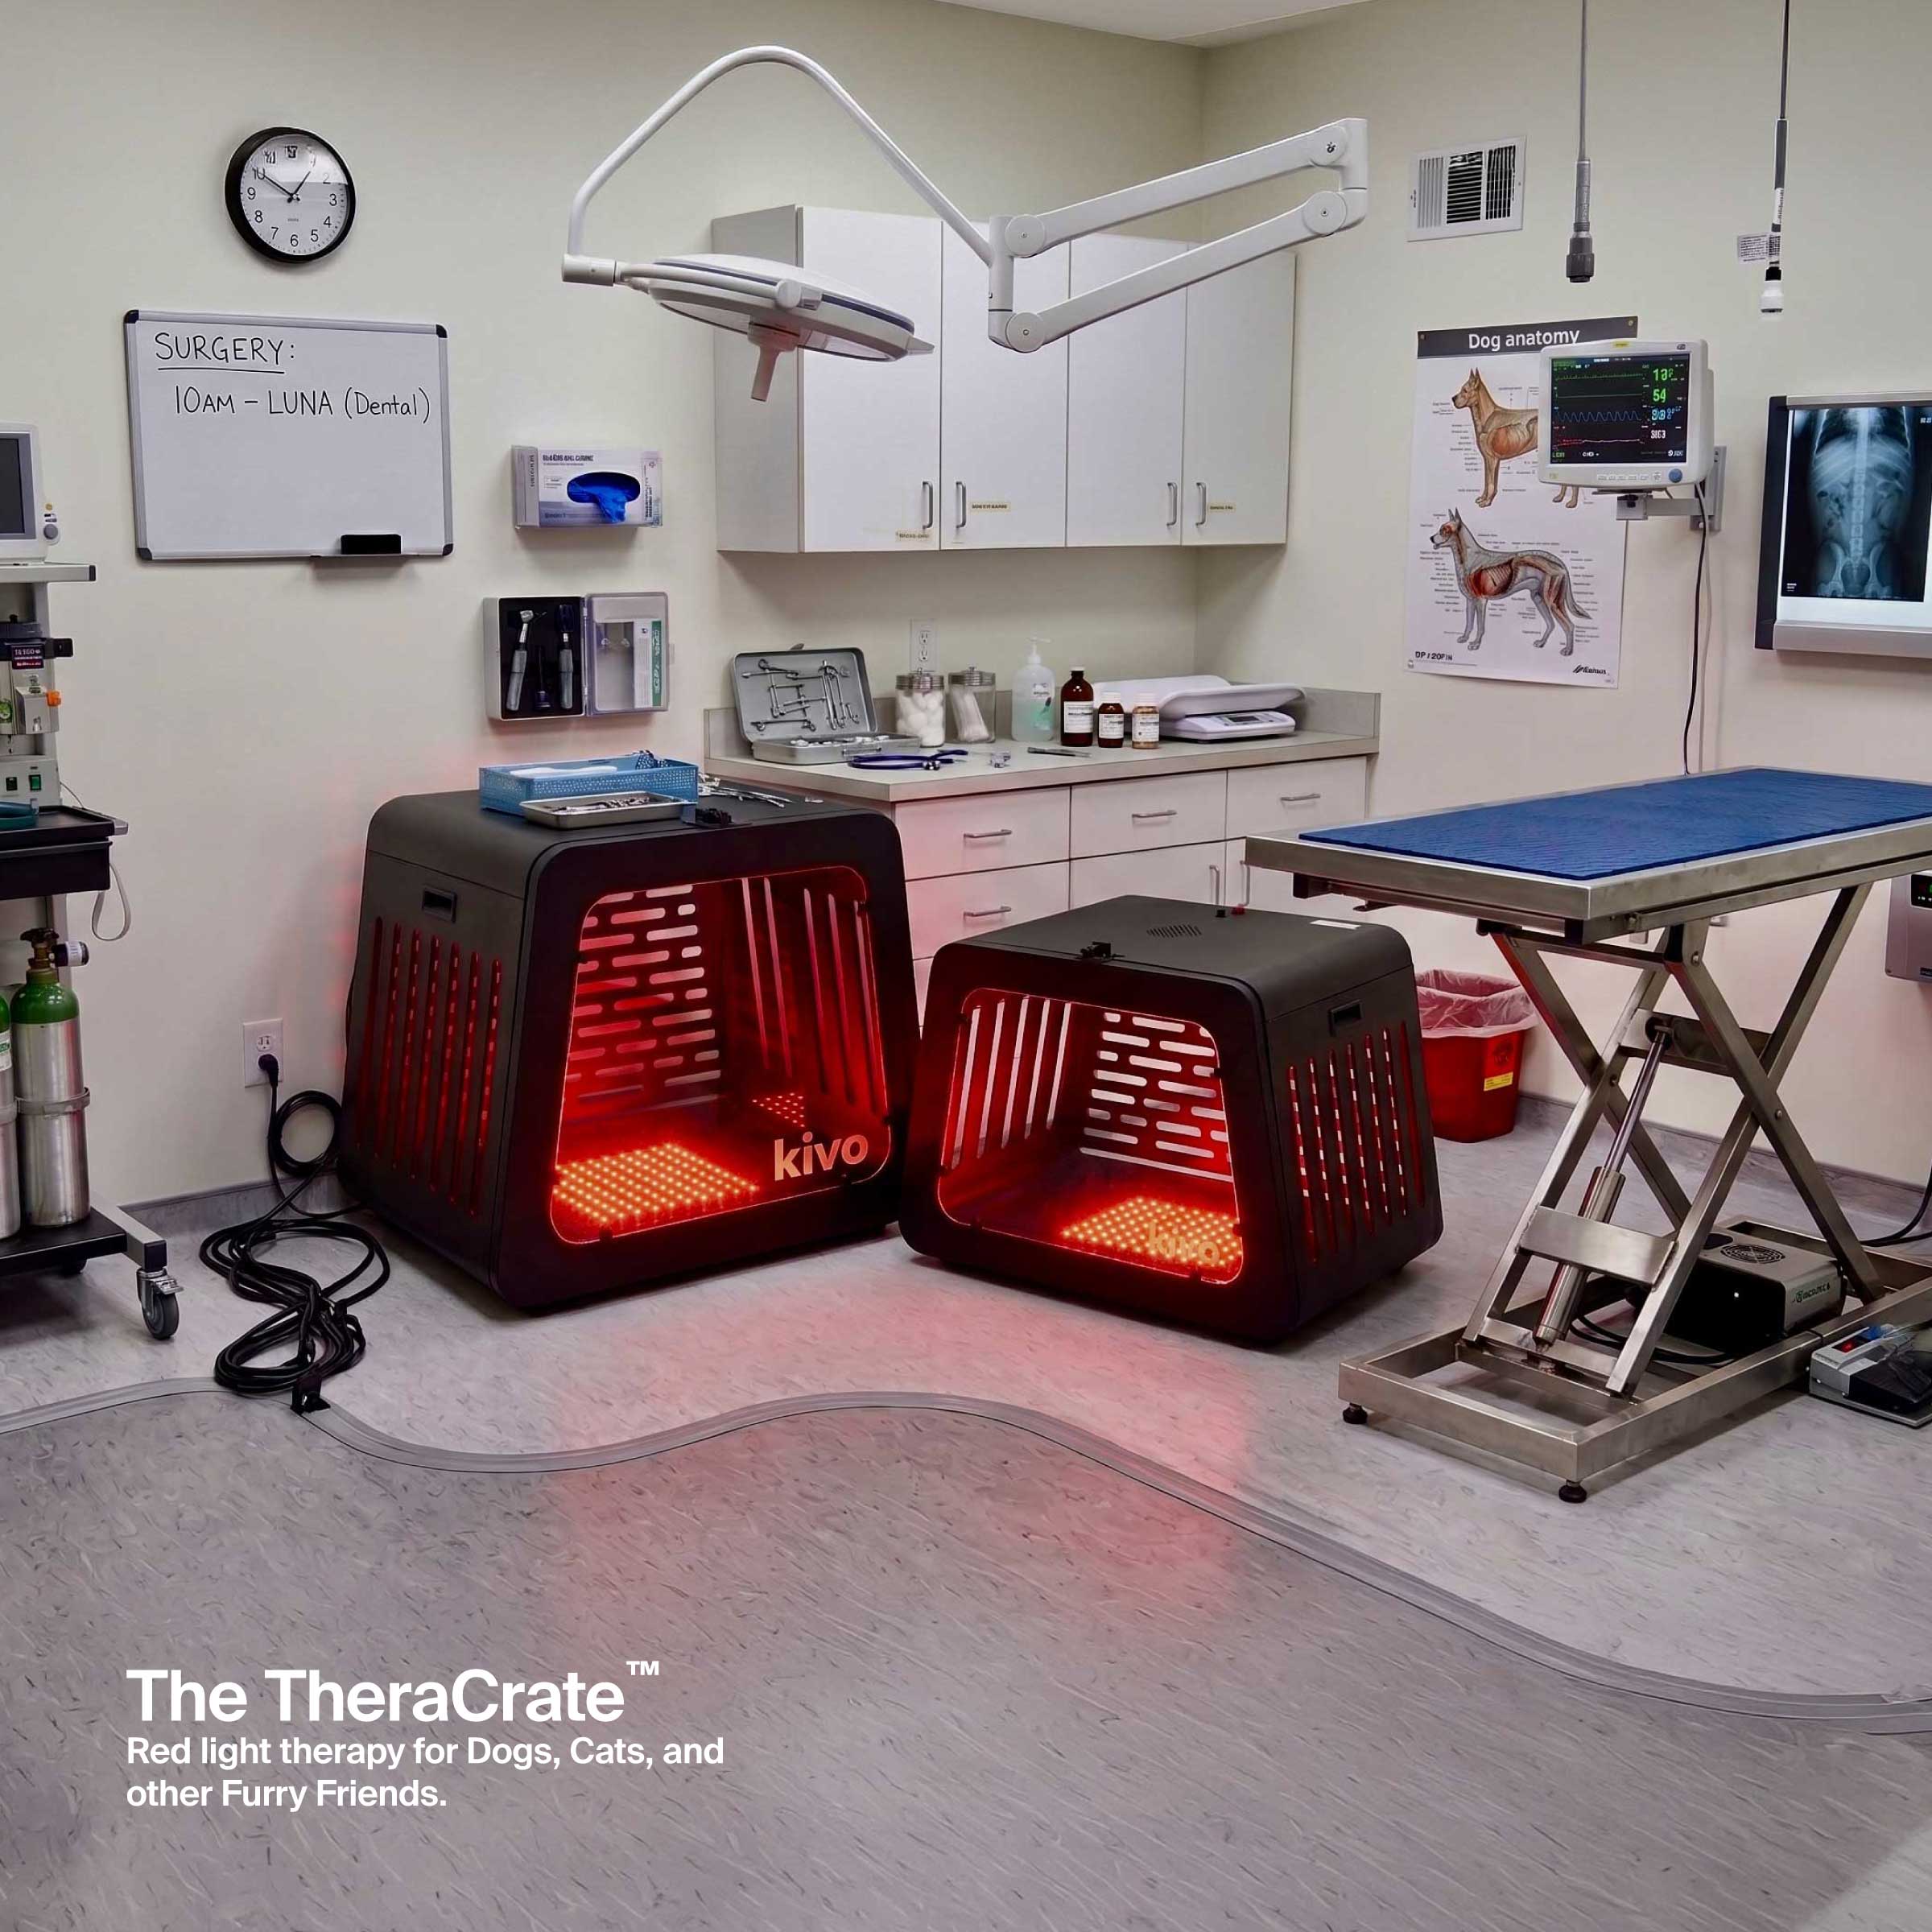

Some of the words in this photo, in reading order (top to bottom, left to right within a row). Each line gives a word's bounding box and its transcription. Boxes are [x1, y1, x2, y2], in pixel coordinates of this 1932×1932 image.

[247, 187, 256, 200] 9
[328, 193, 337, 206] 3
[254, 210, 263, 223] 8
[323, 216, 332, 228] 4
[270, 226, 279, 240] 7
[311, 229, 319, 242] 5
[290, 234, 299, 247] 6
[1468, 333, 1501, 352] Dog
[1505, 329, 1580, 348] anatomy
[155, 332, 295, 365] SURGERY:
[1653, 388, 1666, 402] 54
[175, 385, 236, 415] 10AM
[268, 390, 333, 415] LUNA
[345, 386, 431, 424] (Dental)
[774, 1131, 869, 1182] kivo
